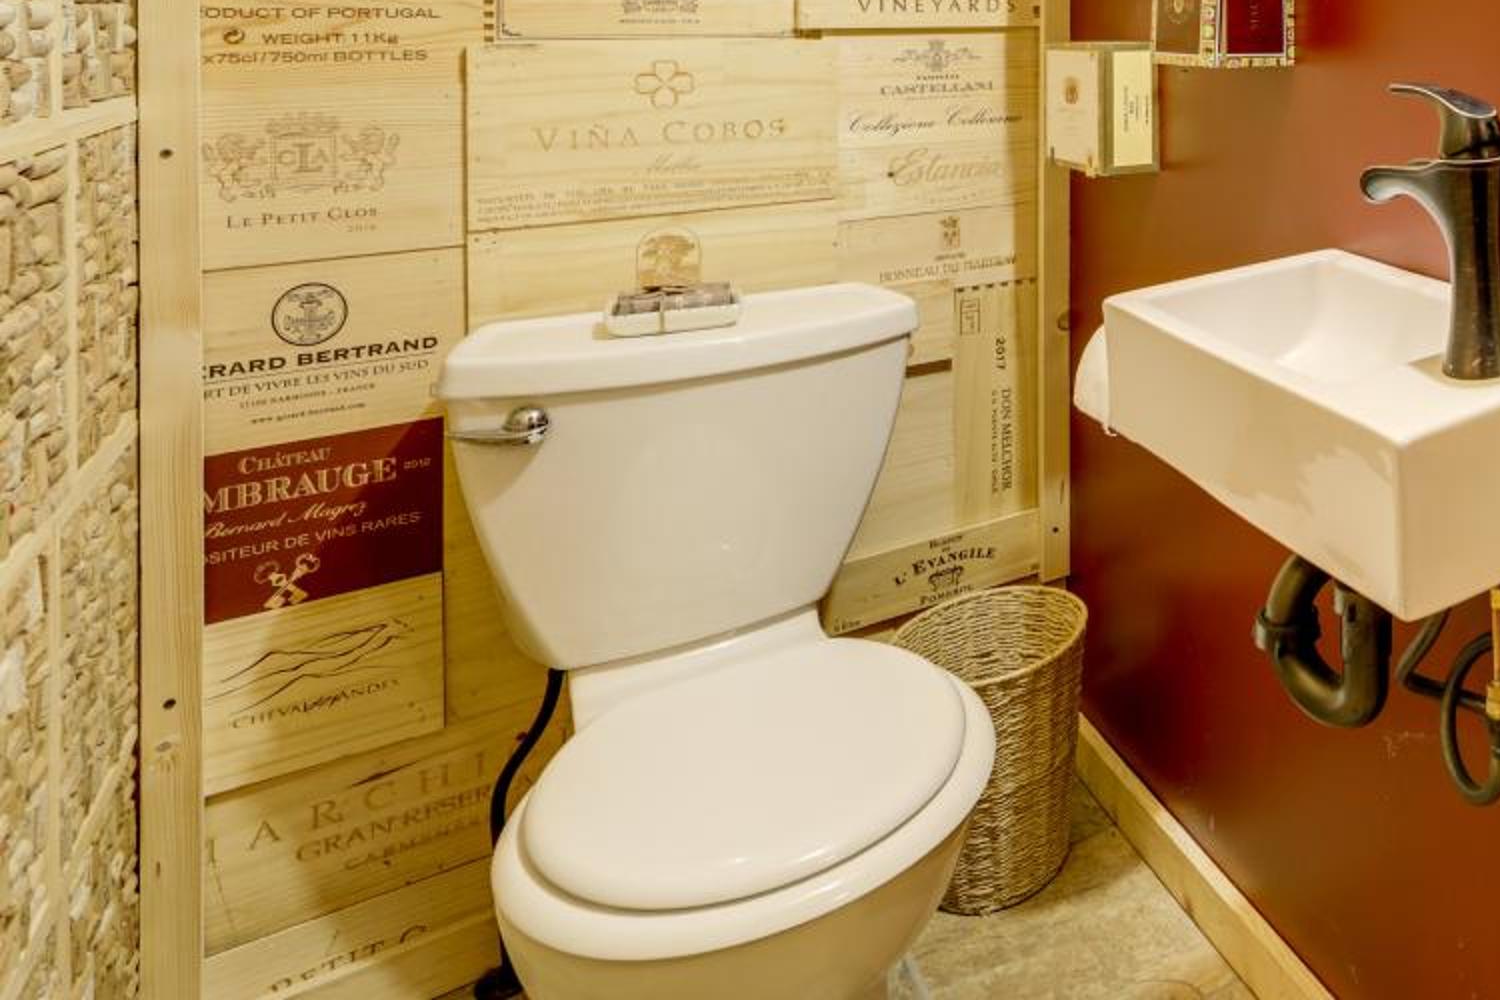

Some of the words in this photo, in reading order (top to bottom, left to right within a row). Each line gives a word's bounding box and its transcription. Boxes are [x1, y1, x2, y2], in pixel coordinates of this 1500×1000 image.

[201, 7, 287, 20] ODUCT
[290, 7, 321, 19] OF
[326, 7, 441, 19] PORTUGAL
[261, 31, 343, 45] WEIGHT
[332, 49, 429, 62] BOTTLES
[879, 81, 994, 98] CASTELLANI
[532, 123, 641, 153] VIÑA
[662, 117, 788, 145] COBOS
[261, 210, 321, 226] PETIT
[202, 356, 287, 380] RARD
[296, 336, 438, 367] BERTRAND
[229, 383, 250, 397] DE
[254, 377, 301, 394] VIVRE
[306, 373, 331, 386] LES
[333, 367, 370, 382] VINS
[372, 362, 396, 377] DU
[398, 358, 429, 373] SUD
[1001, 387, 1013, 420] DON
[237, 447, 332, 475] CHÂTEAU
[1001, 423, 1015, 493] MELCHOR
[285, 533, 310, 550] DE
[315, 524, 358, 542] VINS
[361, 510, 424, 533] RARES
[910, 547, 997, 577] EVANGILE
